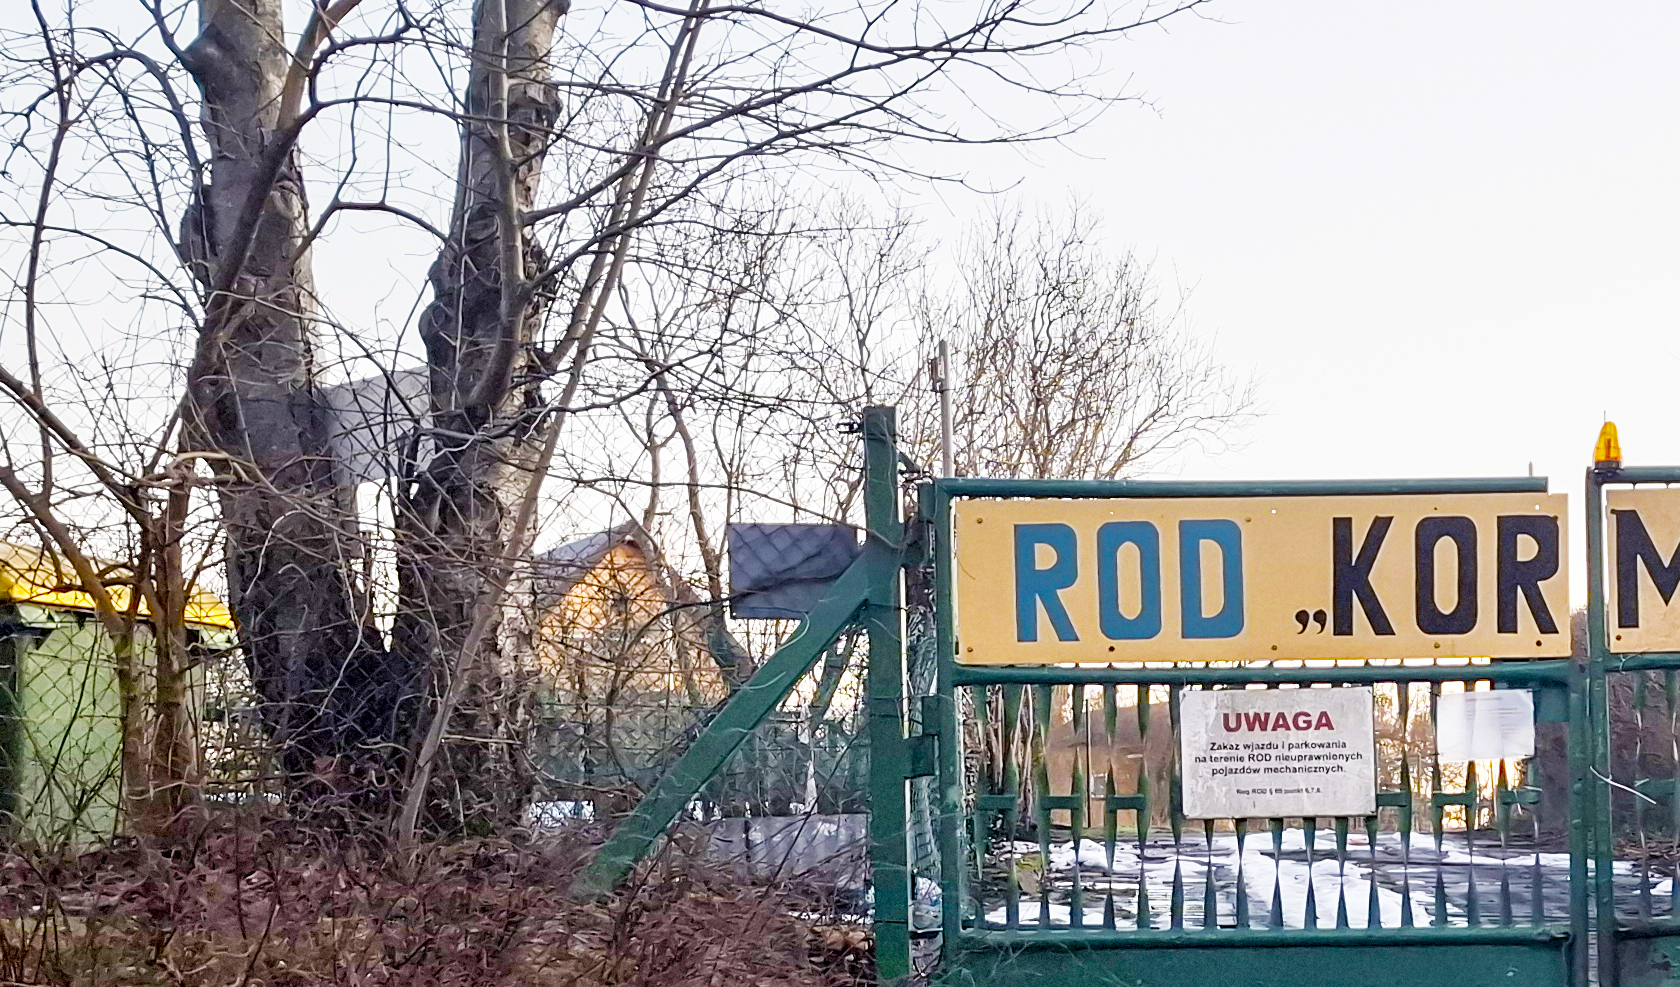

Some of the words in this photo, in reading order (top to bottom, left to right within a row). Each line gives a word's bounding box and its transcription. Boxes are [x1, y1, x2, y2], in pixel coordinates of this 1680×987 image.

[1013, 519, 1244, 642] ROD
[1295, 515, 1560, 636] „KOR
[1222, 710, 1335, 733] UWAGA
[1209, 742, 1240, 751] Zakaz
[1242, 741, 1279, 752] wjazdu
[1281, 740, 1285, 749] i
[1288, 739, 1347, 752] parkowania
[1209, 753, 1245, 763] terenie
[1248, 753, 1272, 762] ROD
[1211, 765, 1261, 777] pojazdów
